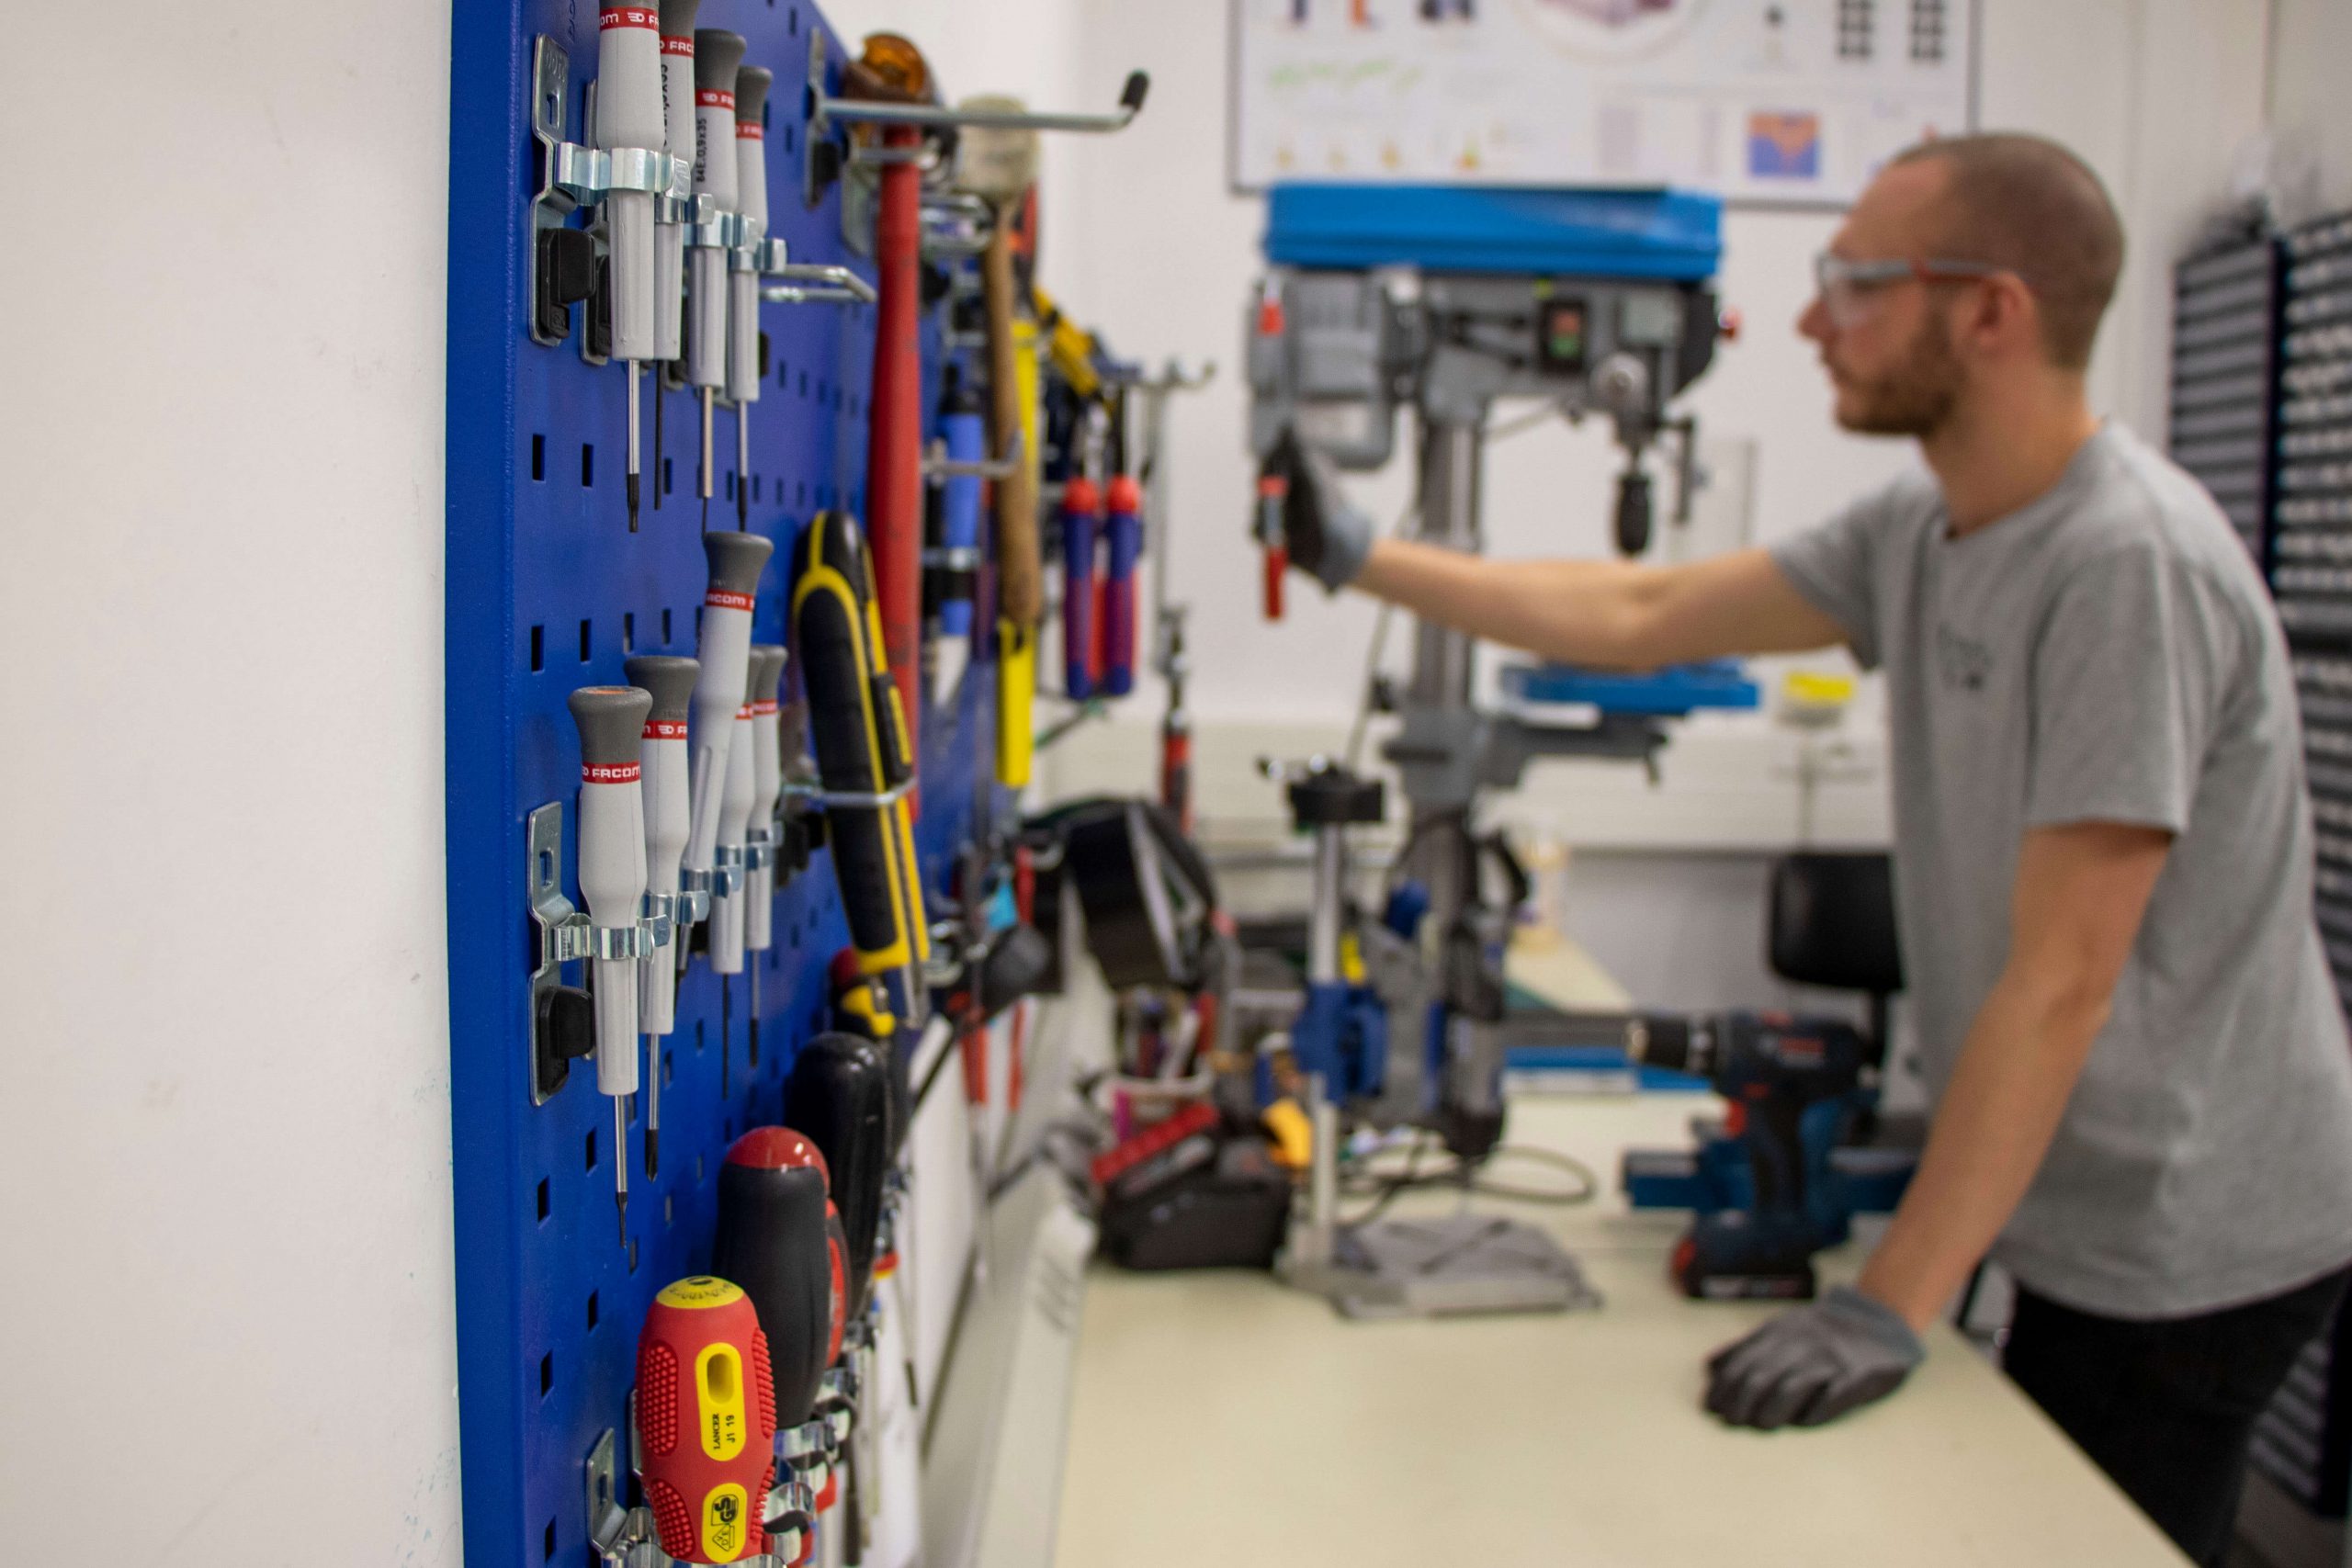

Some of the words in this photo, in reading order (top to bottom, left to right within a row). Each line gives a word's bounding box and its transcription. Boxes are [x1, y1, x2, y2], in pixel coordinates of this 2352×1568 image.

[670, 41, 694, 53] FAC
[593, 766, 640, 778] FACOM
[726, 1415, 735, 1427] 19
[712, 1413, 721, 1450] LANCER
